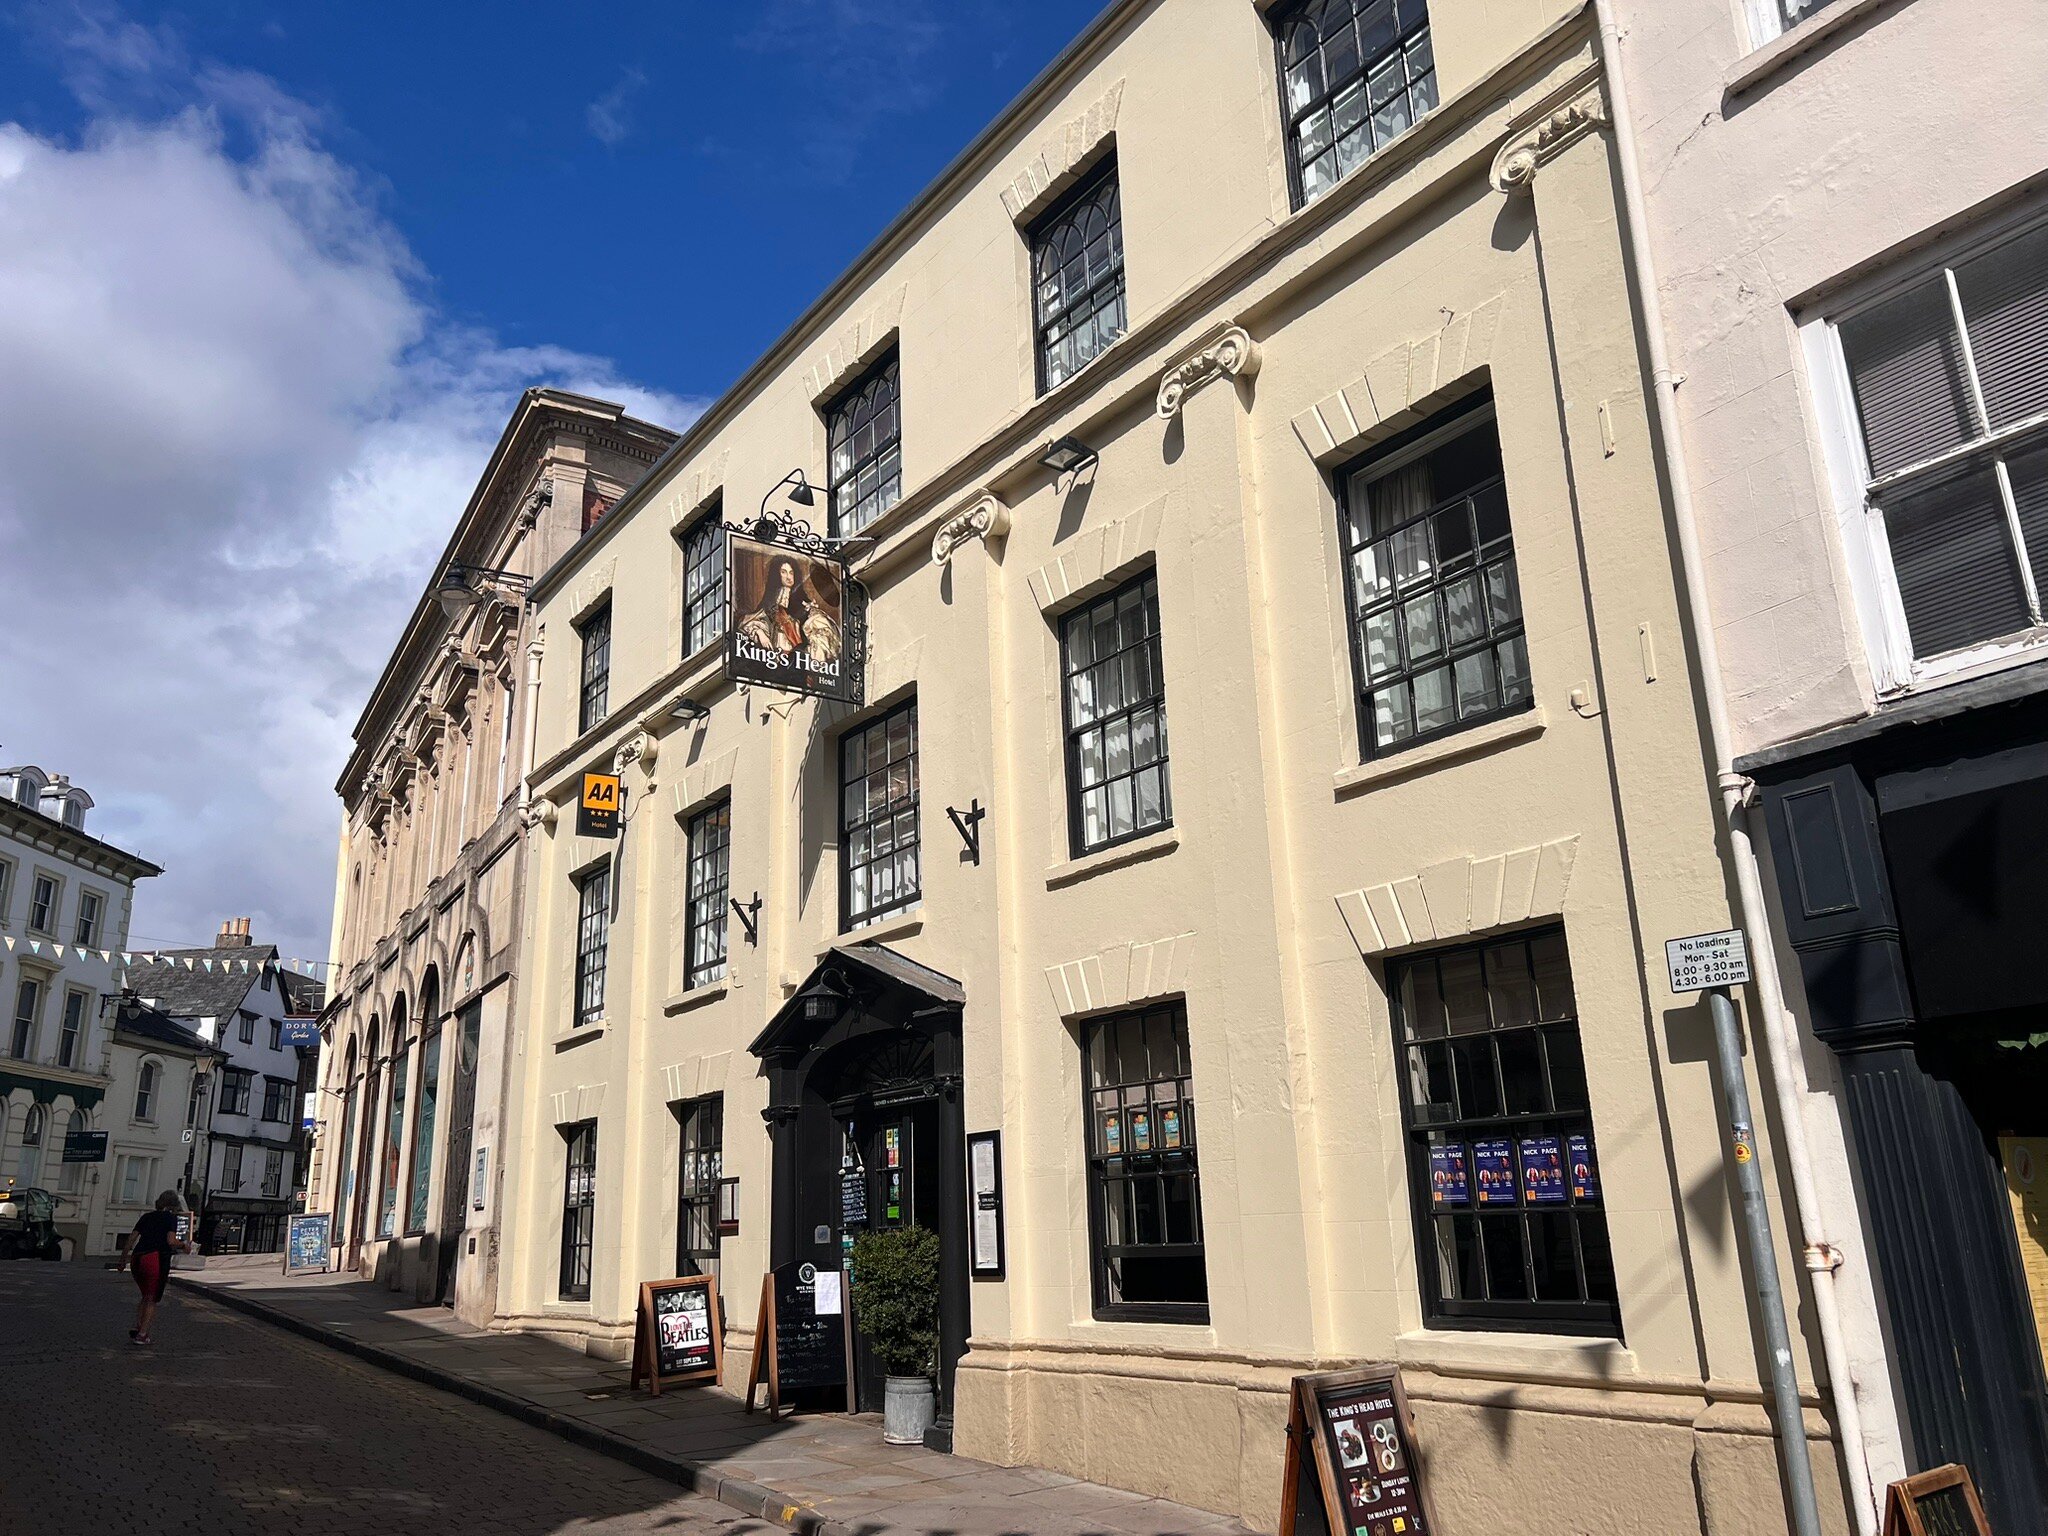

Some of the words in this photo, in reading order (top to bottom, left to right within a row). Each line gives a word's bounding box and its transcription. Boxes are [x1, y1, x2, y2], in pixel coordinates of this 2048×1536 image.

[736, 631, 749, 640] The
[736, 638, 789, 670] King's
[795, 650, 840, 676] Head
[818, 676, 836, 687] Hotel
[587, 782, 613, 803] AA
[591, 821, 608, 829] Hotel
[1680, 943, 1693, 952] No
[1695, 938, 1730, 949] loading
[1684, 954, 1705, 963] Mon
[1712, 949, 1729, 959] Sat
[1674, 965, 1697, 977] 8.00
[1703, 961, 1727, 973] 9.30
[1729, 960, 1744, 969] am
[1675, 976, 1698, 987] 4.30
[1705, 972, 1728, 983] 6.00
[1730, 971, 1745, 980] pm
[661, 1322, 709, 1346] BEATLES
[1327, 1408, 1340, 1419] THE
[1339, 1404, 1359, 1417] KING'S
[1358, 1401, 1375, 1413] HEAD
[1374, 1398, 1393, 1410] HOTEL
